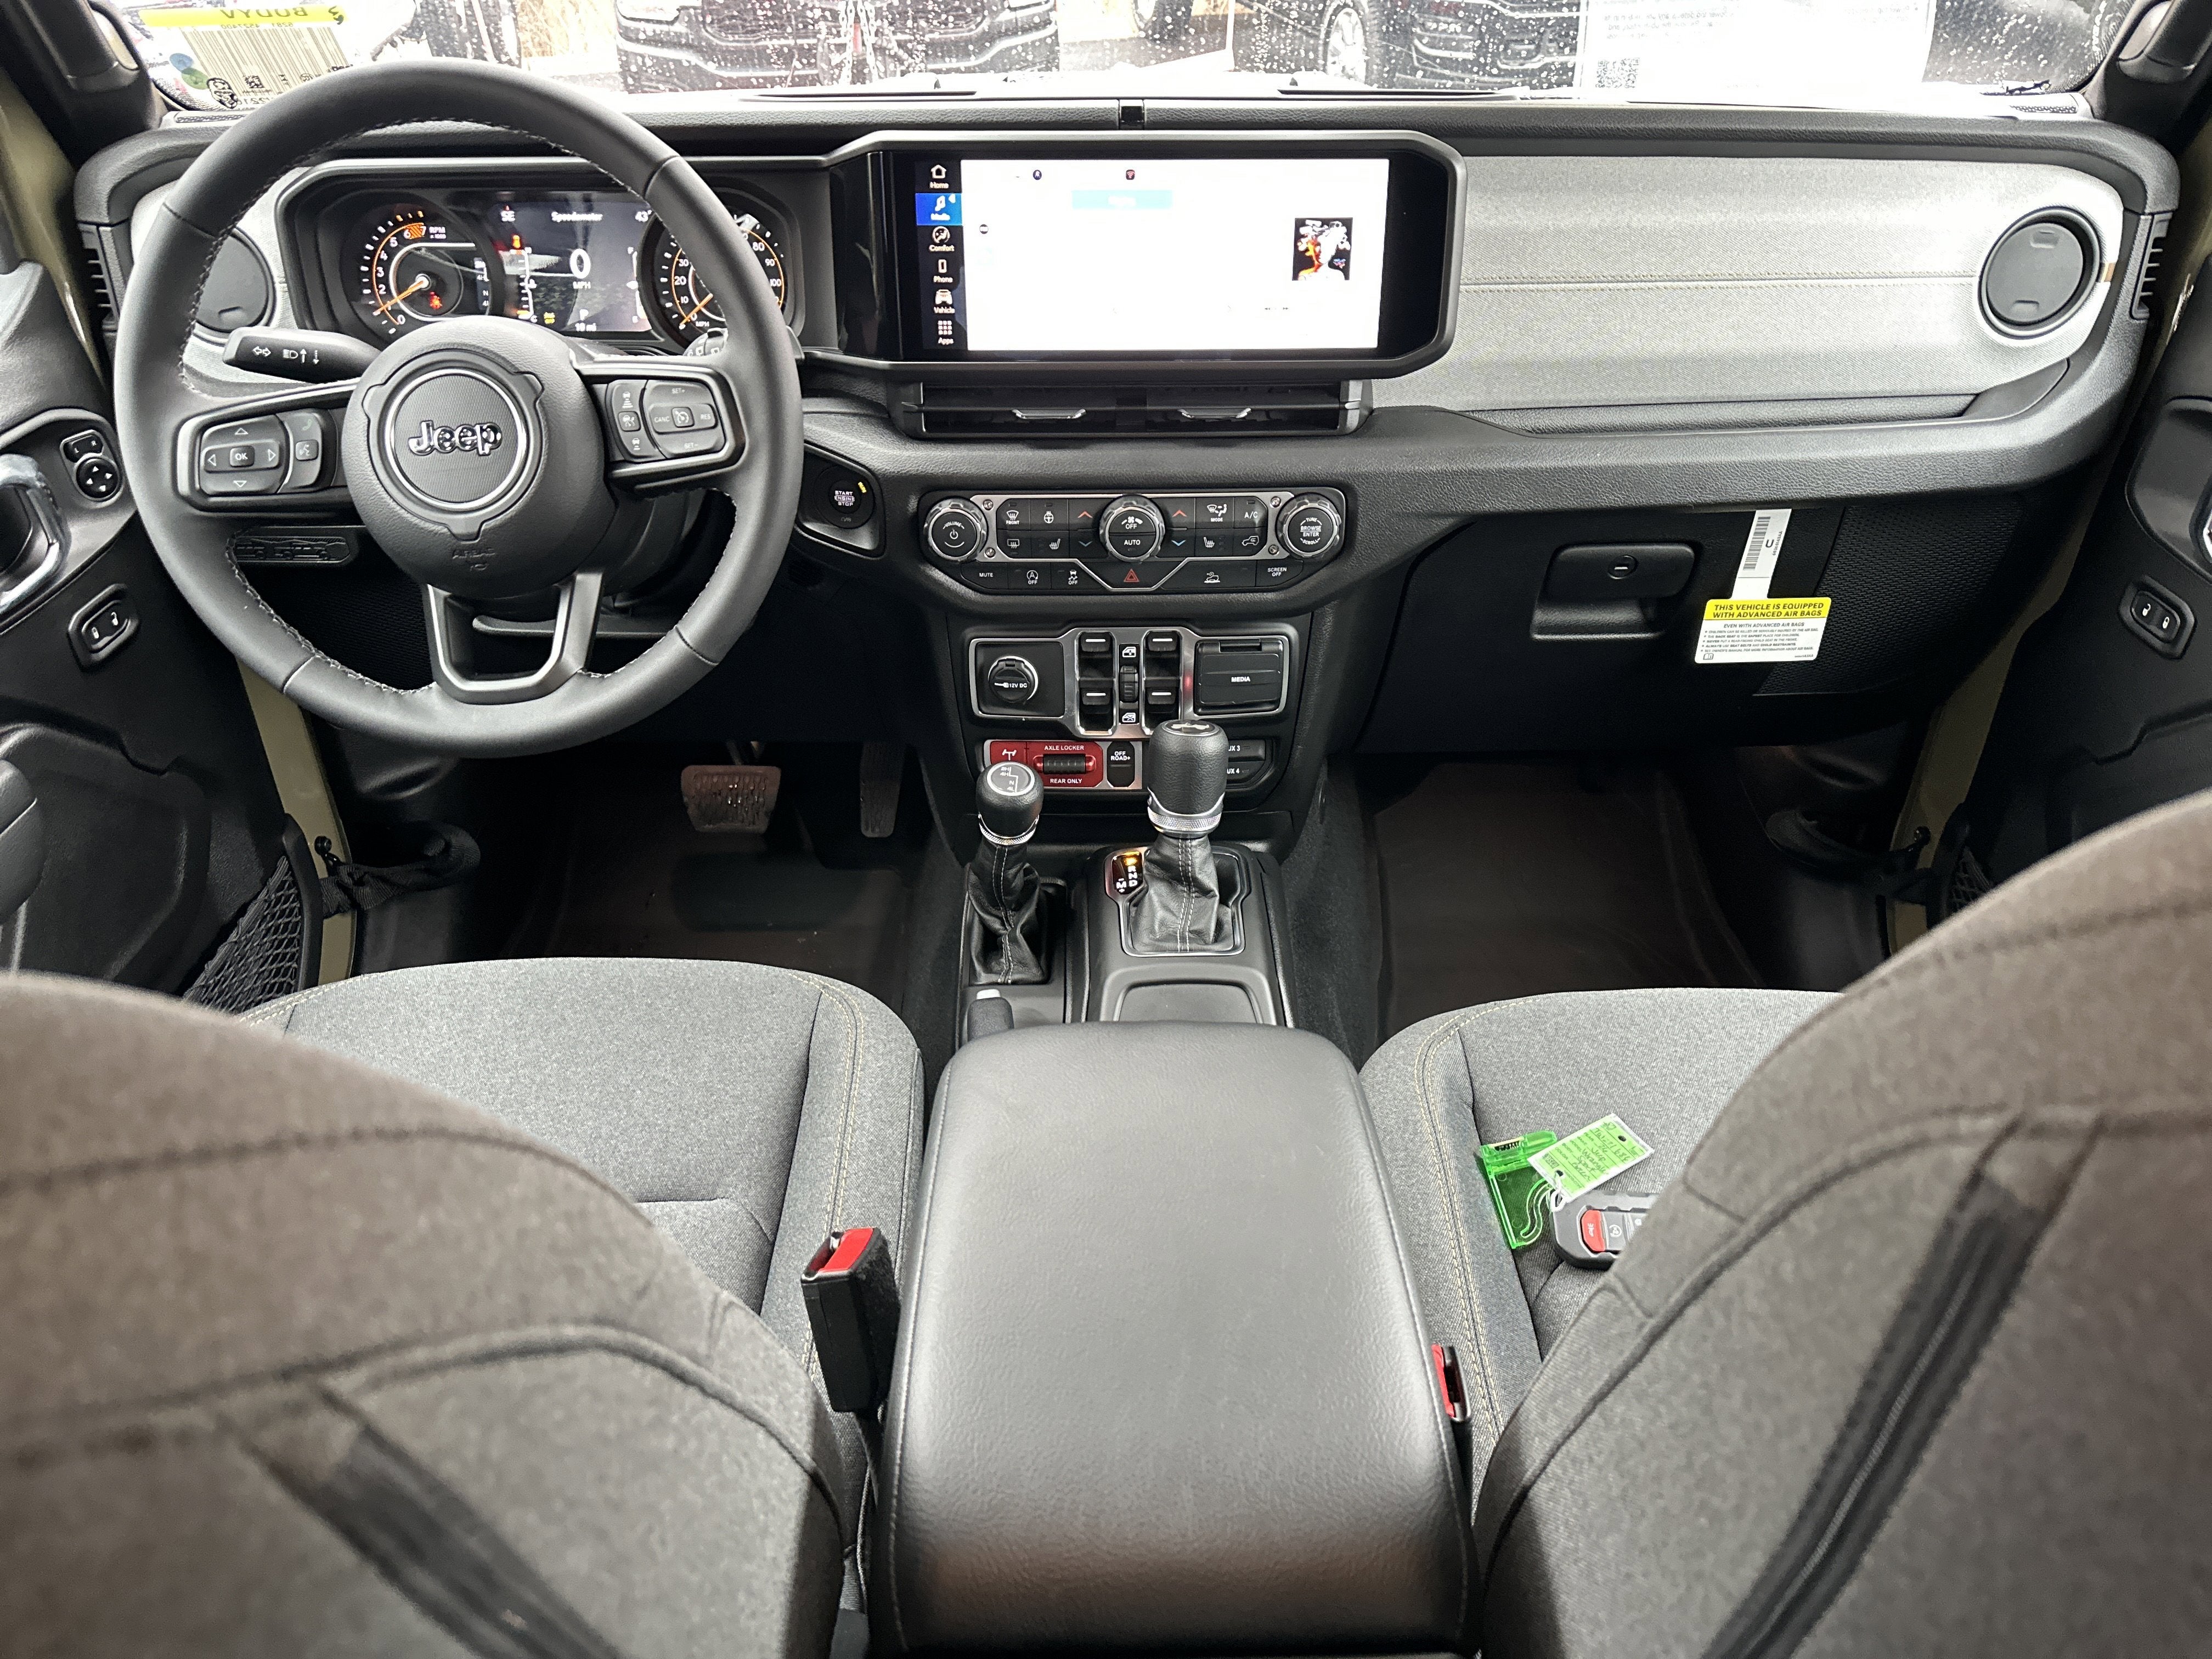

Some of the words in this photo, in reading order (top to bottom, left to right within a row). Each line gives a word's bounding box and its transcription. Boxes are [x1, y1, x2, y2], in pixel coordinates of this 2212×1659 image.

[390, 236, 398, 247] 5
[752, 241, 765, 251] 80
[380, 250, 387, 261] 4
[570, 248, 591, 279] 0
[679, 258, 689, 267] 30
[765, 258, 775, 267] 90
[376, 267, 384, 277] 3
[674, 276, 687, 285] 20
[770, 278, 782, 287] 100
[379, 284, 386, 295] 2
[398, 314, 406, 325] 0
[938, 337, 954, 345] Apps
[408, 420, 503, 456] Jeep
[235, 453, 248, 461] OK
[1244, 511, 1259, 519] A/C
[1562, 1143, 1573, 1153] BODY
